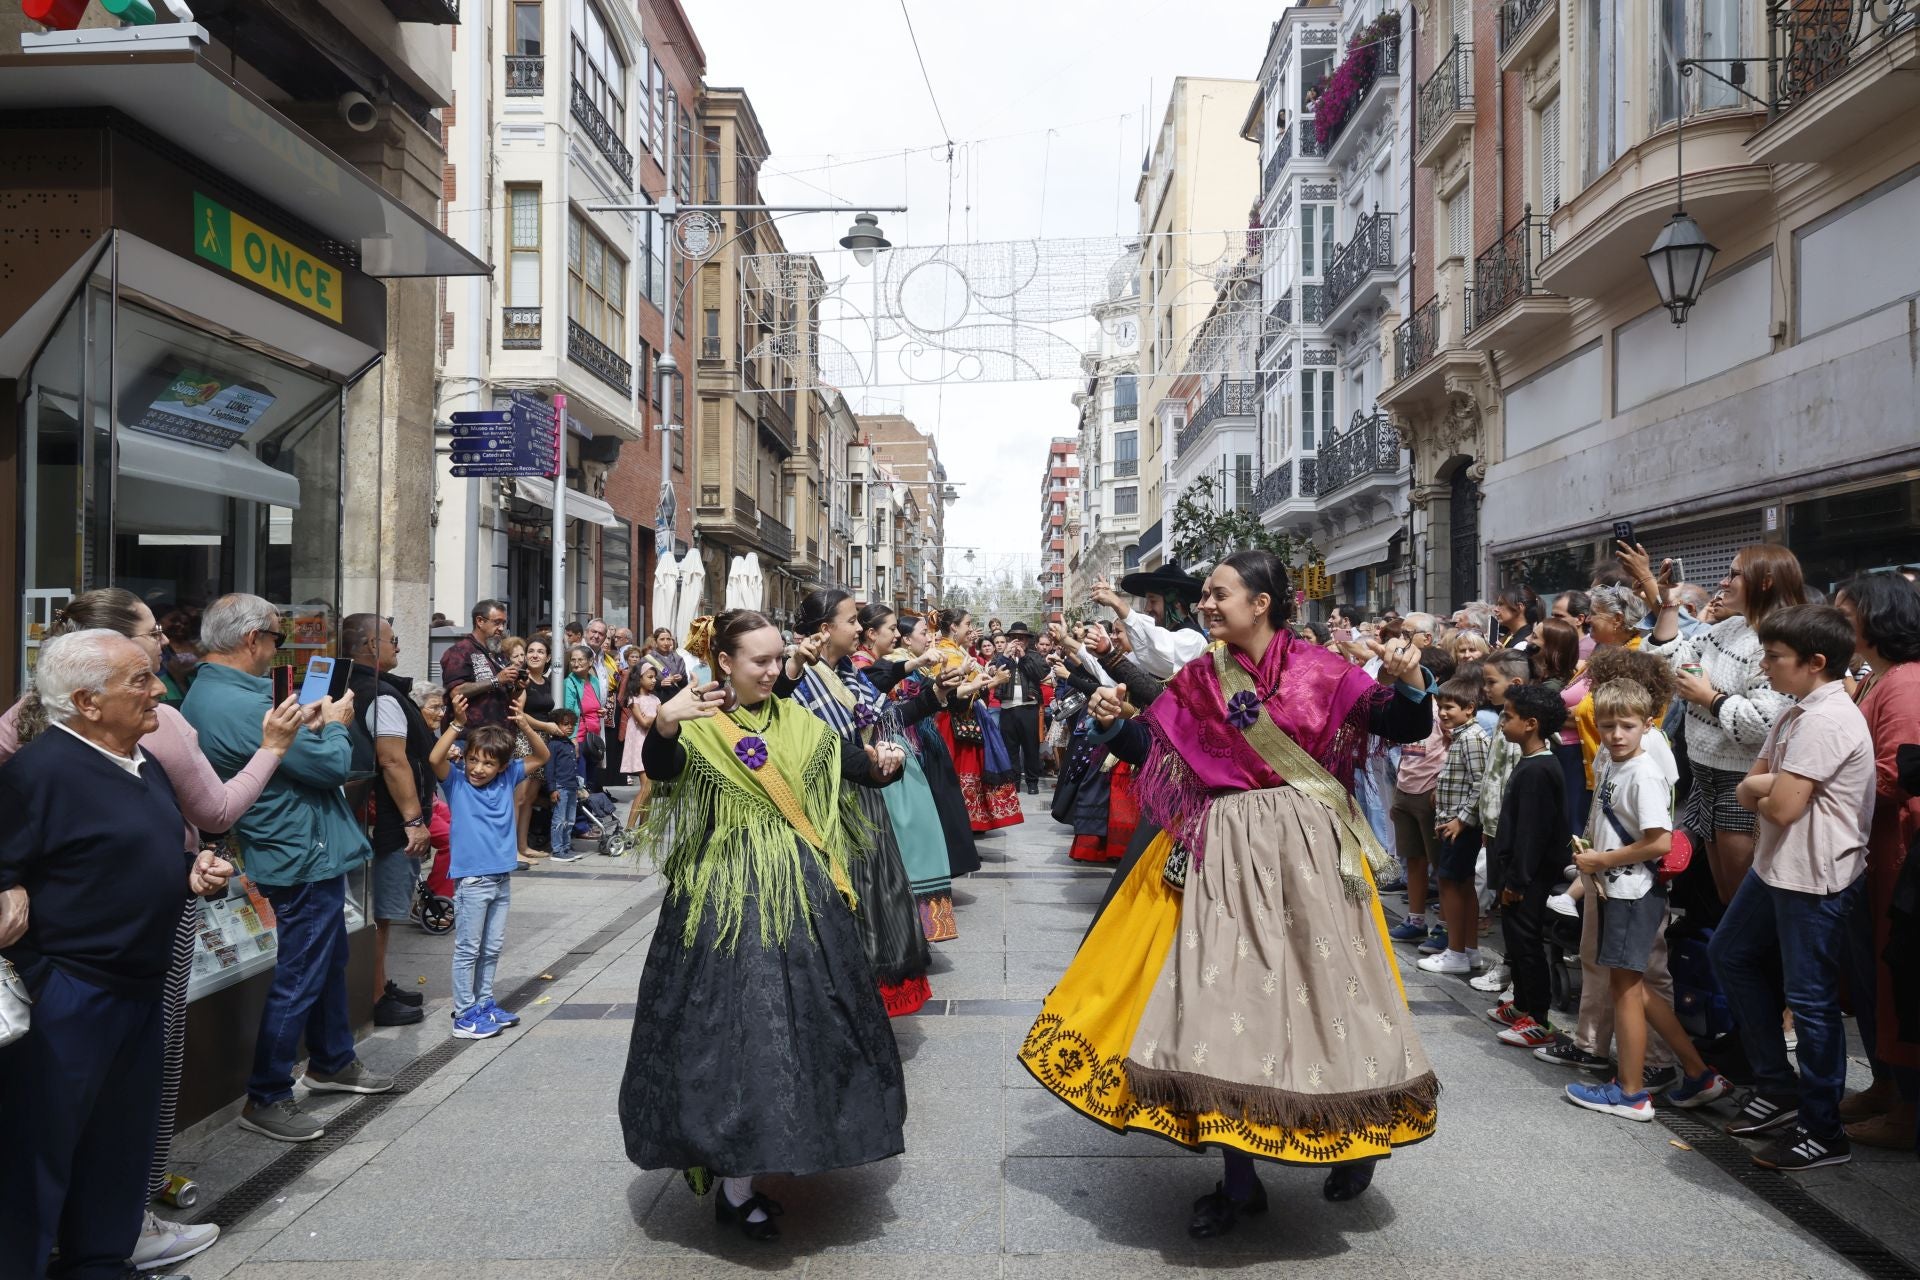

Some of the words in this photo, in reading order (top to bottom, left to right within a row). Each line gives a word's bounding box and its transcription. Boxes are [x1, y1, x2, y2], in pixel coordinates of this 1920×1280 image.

[244, 232, 332, 309] ONCE
[225, 400, 252, 414] LUNES
[214, 410, 250, 426] Septiembre
